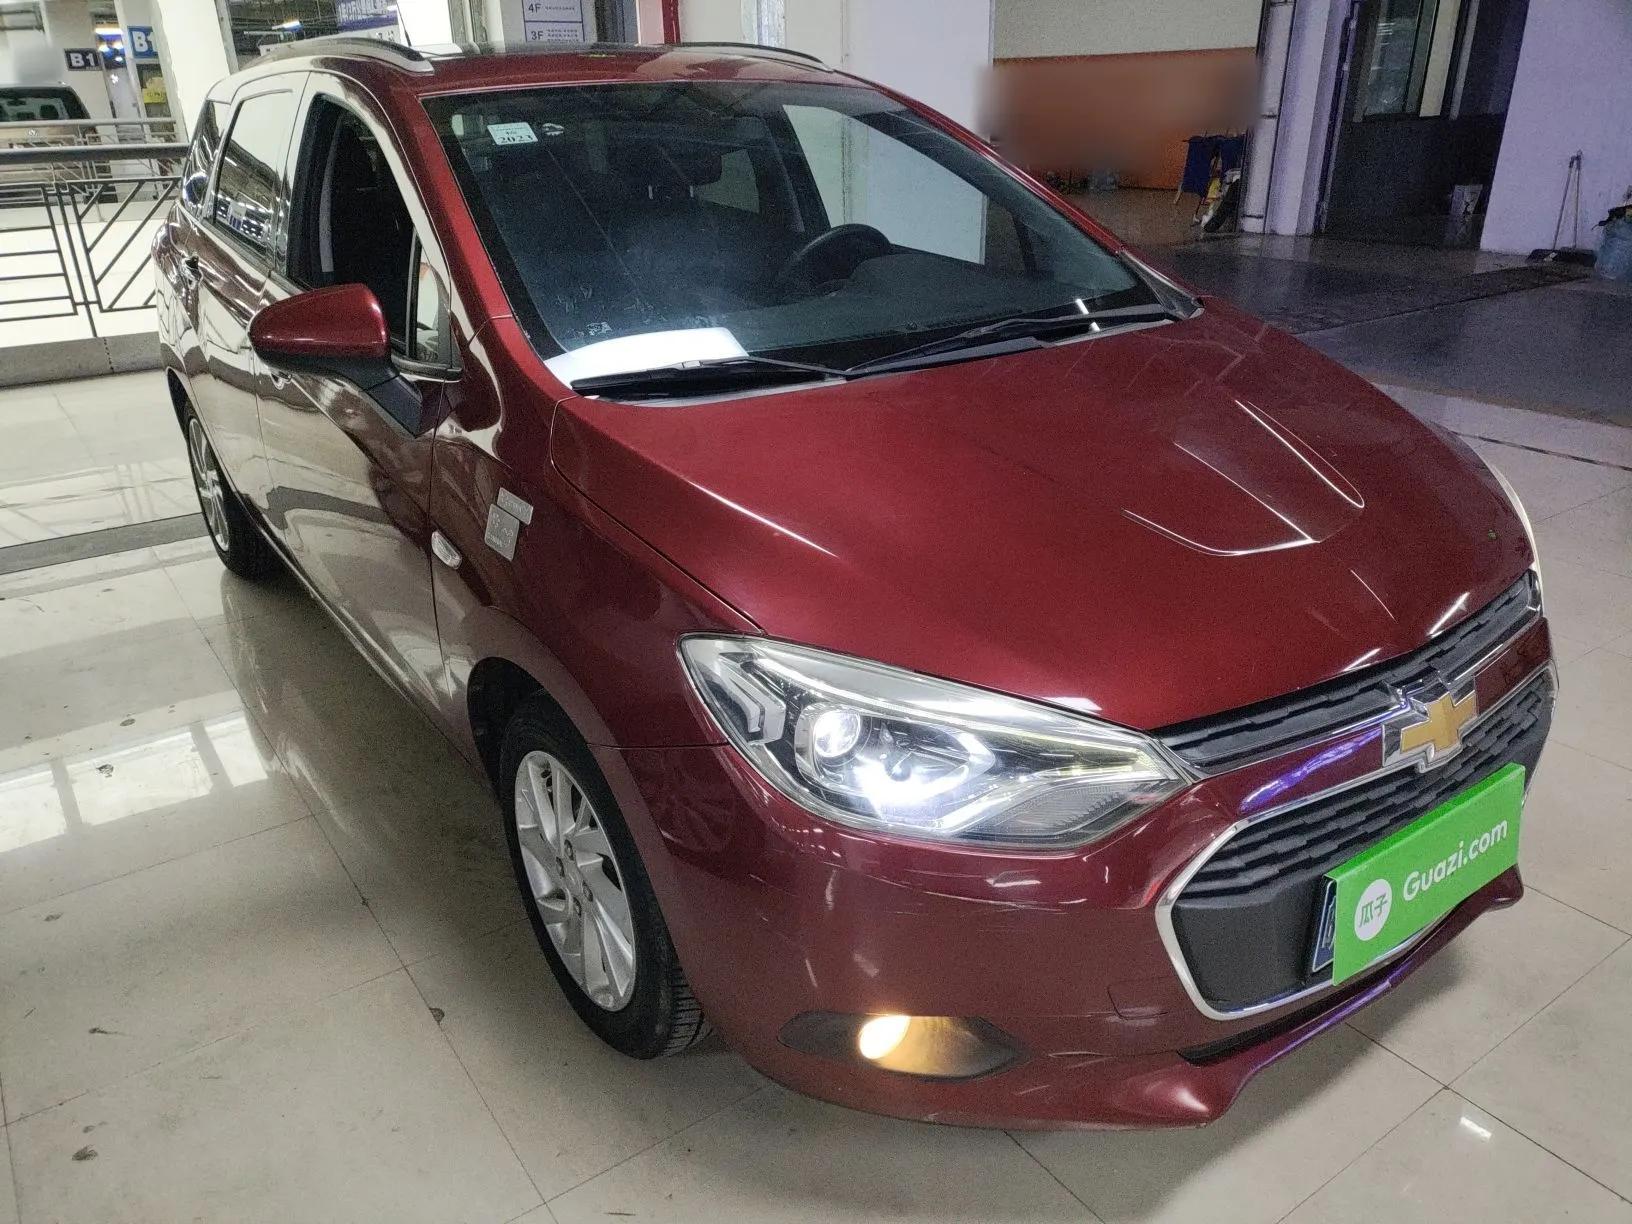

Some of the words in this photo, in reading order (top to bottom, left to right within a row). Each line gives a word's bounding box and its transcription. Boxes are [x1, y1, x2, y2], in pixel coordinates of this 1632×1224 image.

[528, 3, 541, 14] 4F
[530, 30, 544, 41] 3F
[69, 52, 96, 68] B1
[1403, 819, 1509, 902] Guazi.com
[1358, 893, 1389, 929] 瓜子
